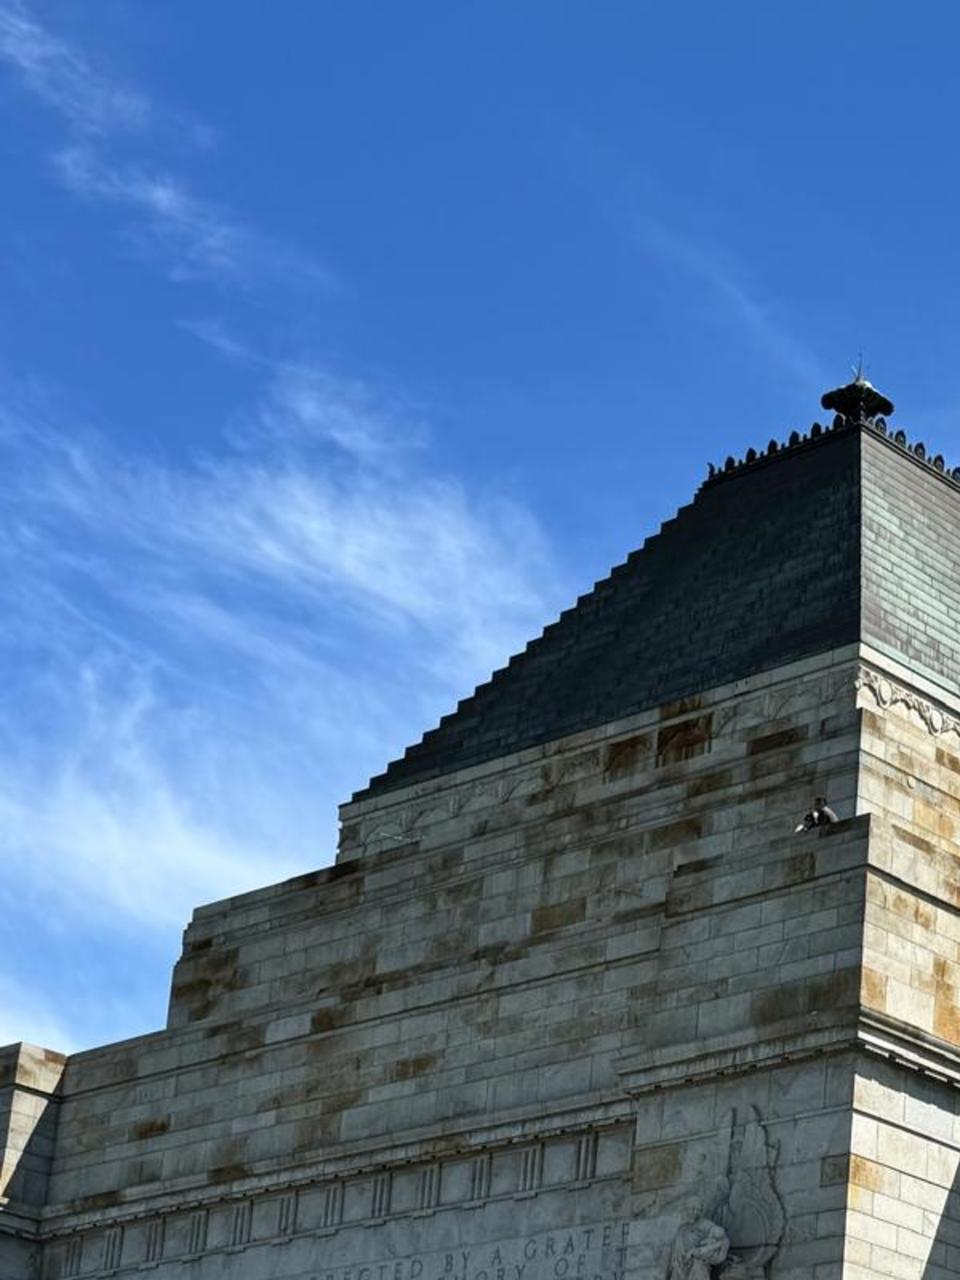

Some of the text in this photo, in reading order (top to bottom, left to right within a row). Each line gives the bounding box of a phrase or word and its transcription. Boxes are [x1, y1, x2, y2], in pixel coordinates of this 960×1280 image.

[445, 1251, 470, 1273] BY
[491, 1245, 502, 1267] A
[554, 1254, 586, 1277] OF
